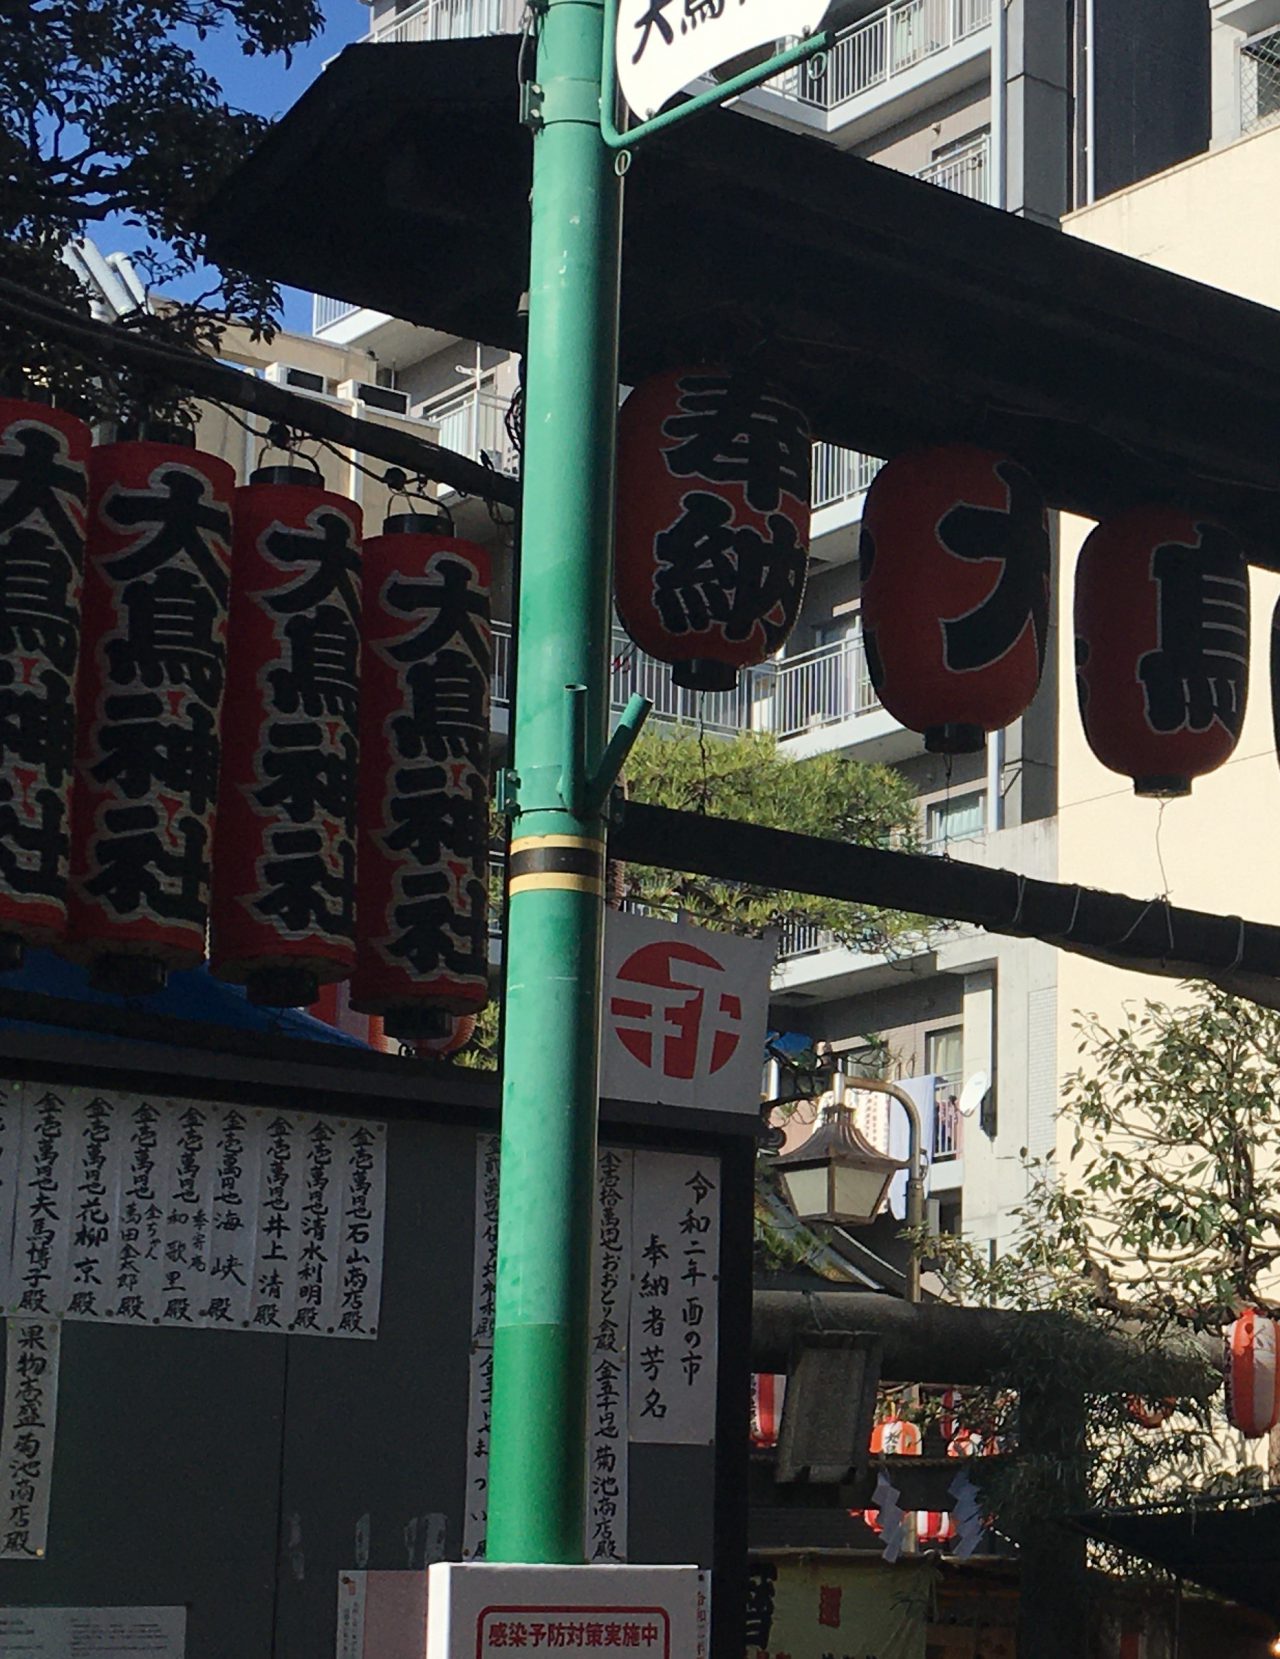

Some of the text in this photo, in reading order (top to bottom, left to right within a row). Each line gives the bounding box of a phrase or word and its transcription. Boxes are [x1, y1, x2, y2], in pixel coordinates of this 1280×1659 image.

[652, 372, 812, 644] 奉納
[1136, 522, 1249, 735] 鳥
[85, 464, 232, 922] 大鳥神社
[245, 508, 361, 940] 大鳥神社
[370, 552, 489, 982] 大鳥神社
[639, 1233, 669, 1418] 奉納者芳名
[679, 1170, 716, 1386] 令和二年酉の市
[489, 1621, 659, 1648] 感染予防対策実施中
